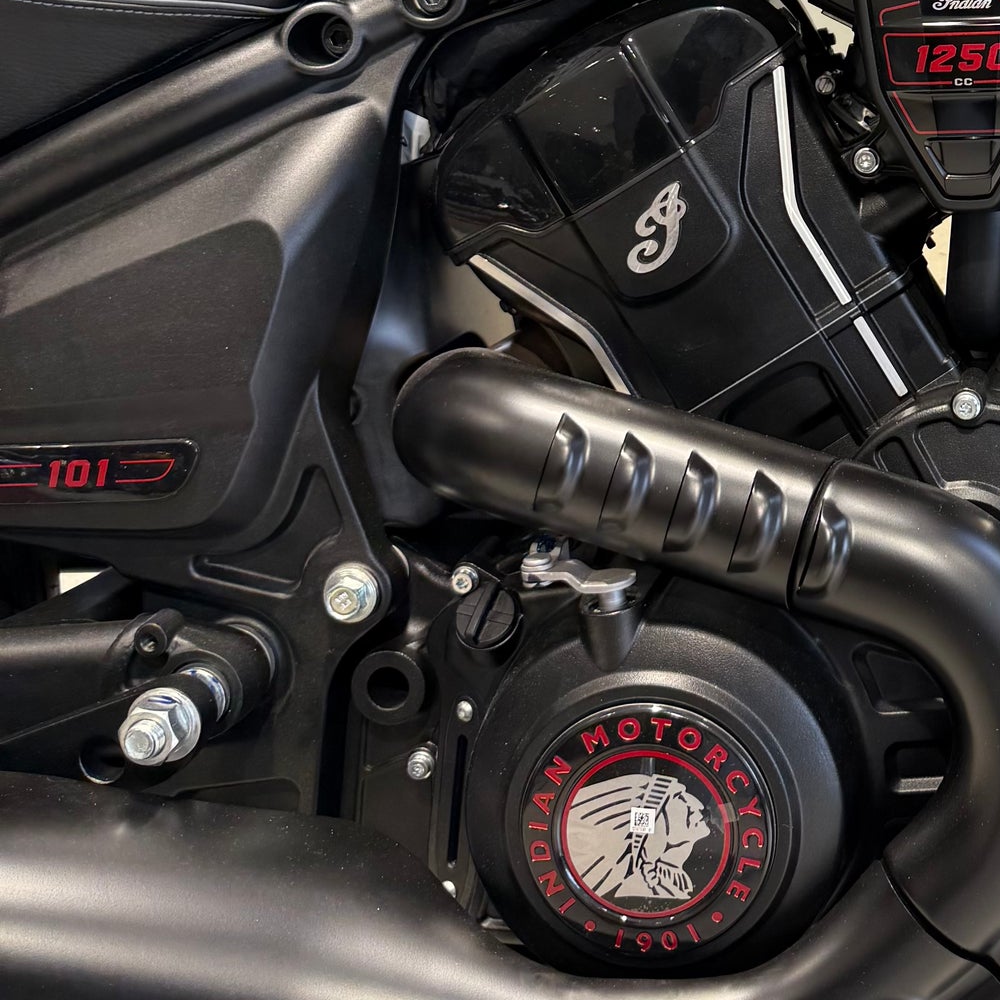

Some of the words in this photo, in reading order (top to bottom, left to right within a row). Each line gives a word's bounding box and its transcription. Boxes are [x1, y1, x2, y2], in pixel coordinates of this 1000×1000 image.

[49, 459, 109, 488] 101
[528, 755, 576, 914] INDIAN
[581, 717, 764, 902] MOTORCYCLE
[614, 923, 701, 952] 1901
